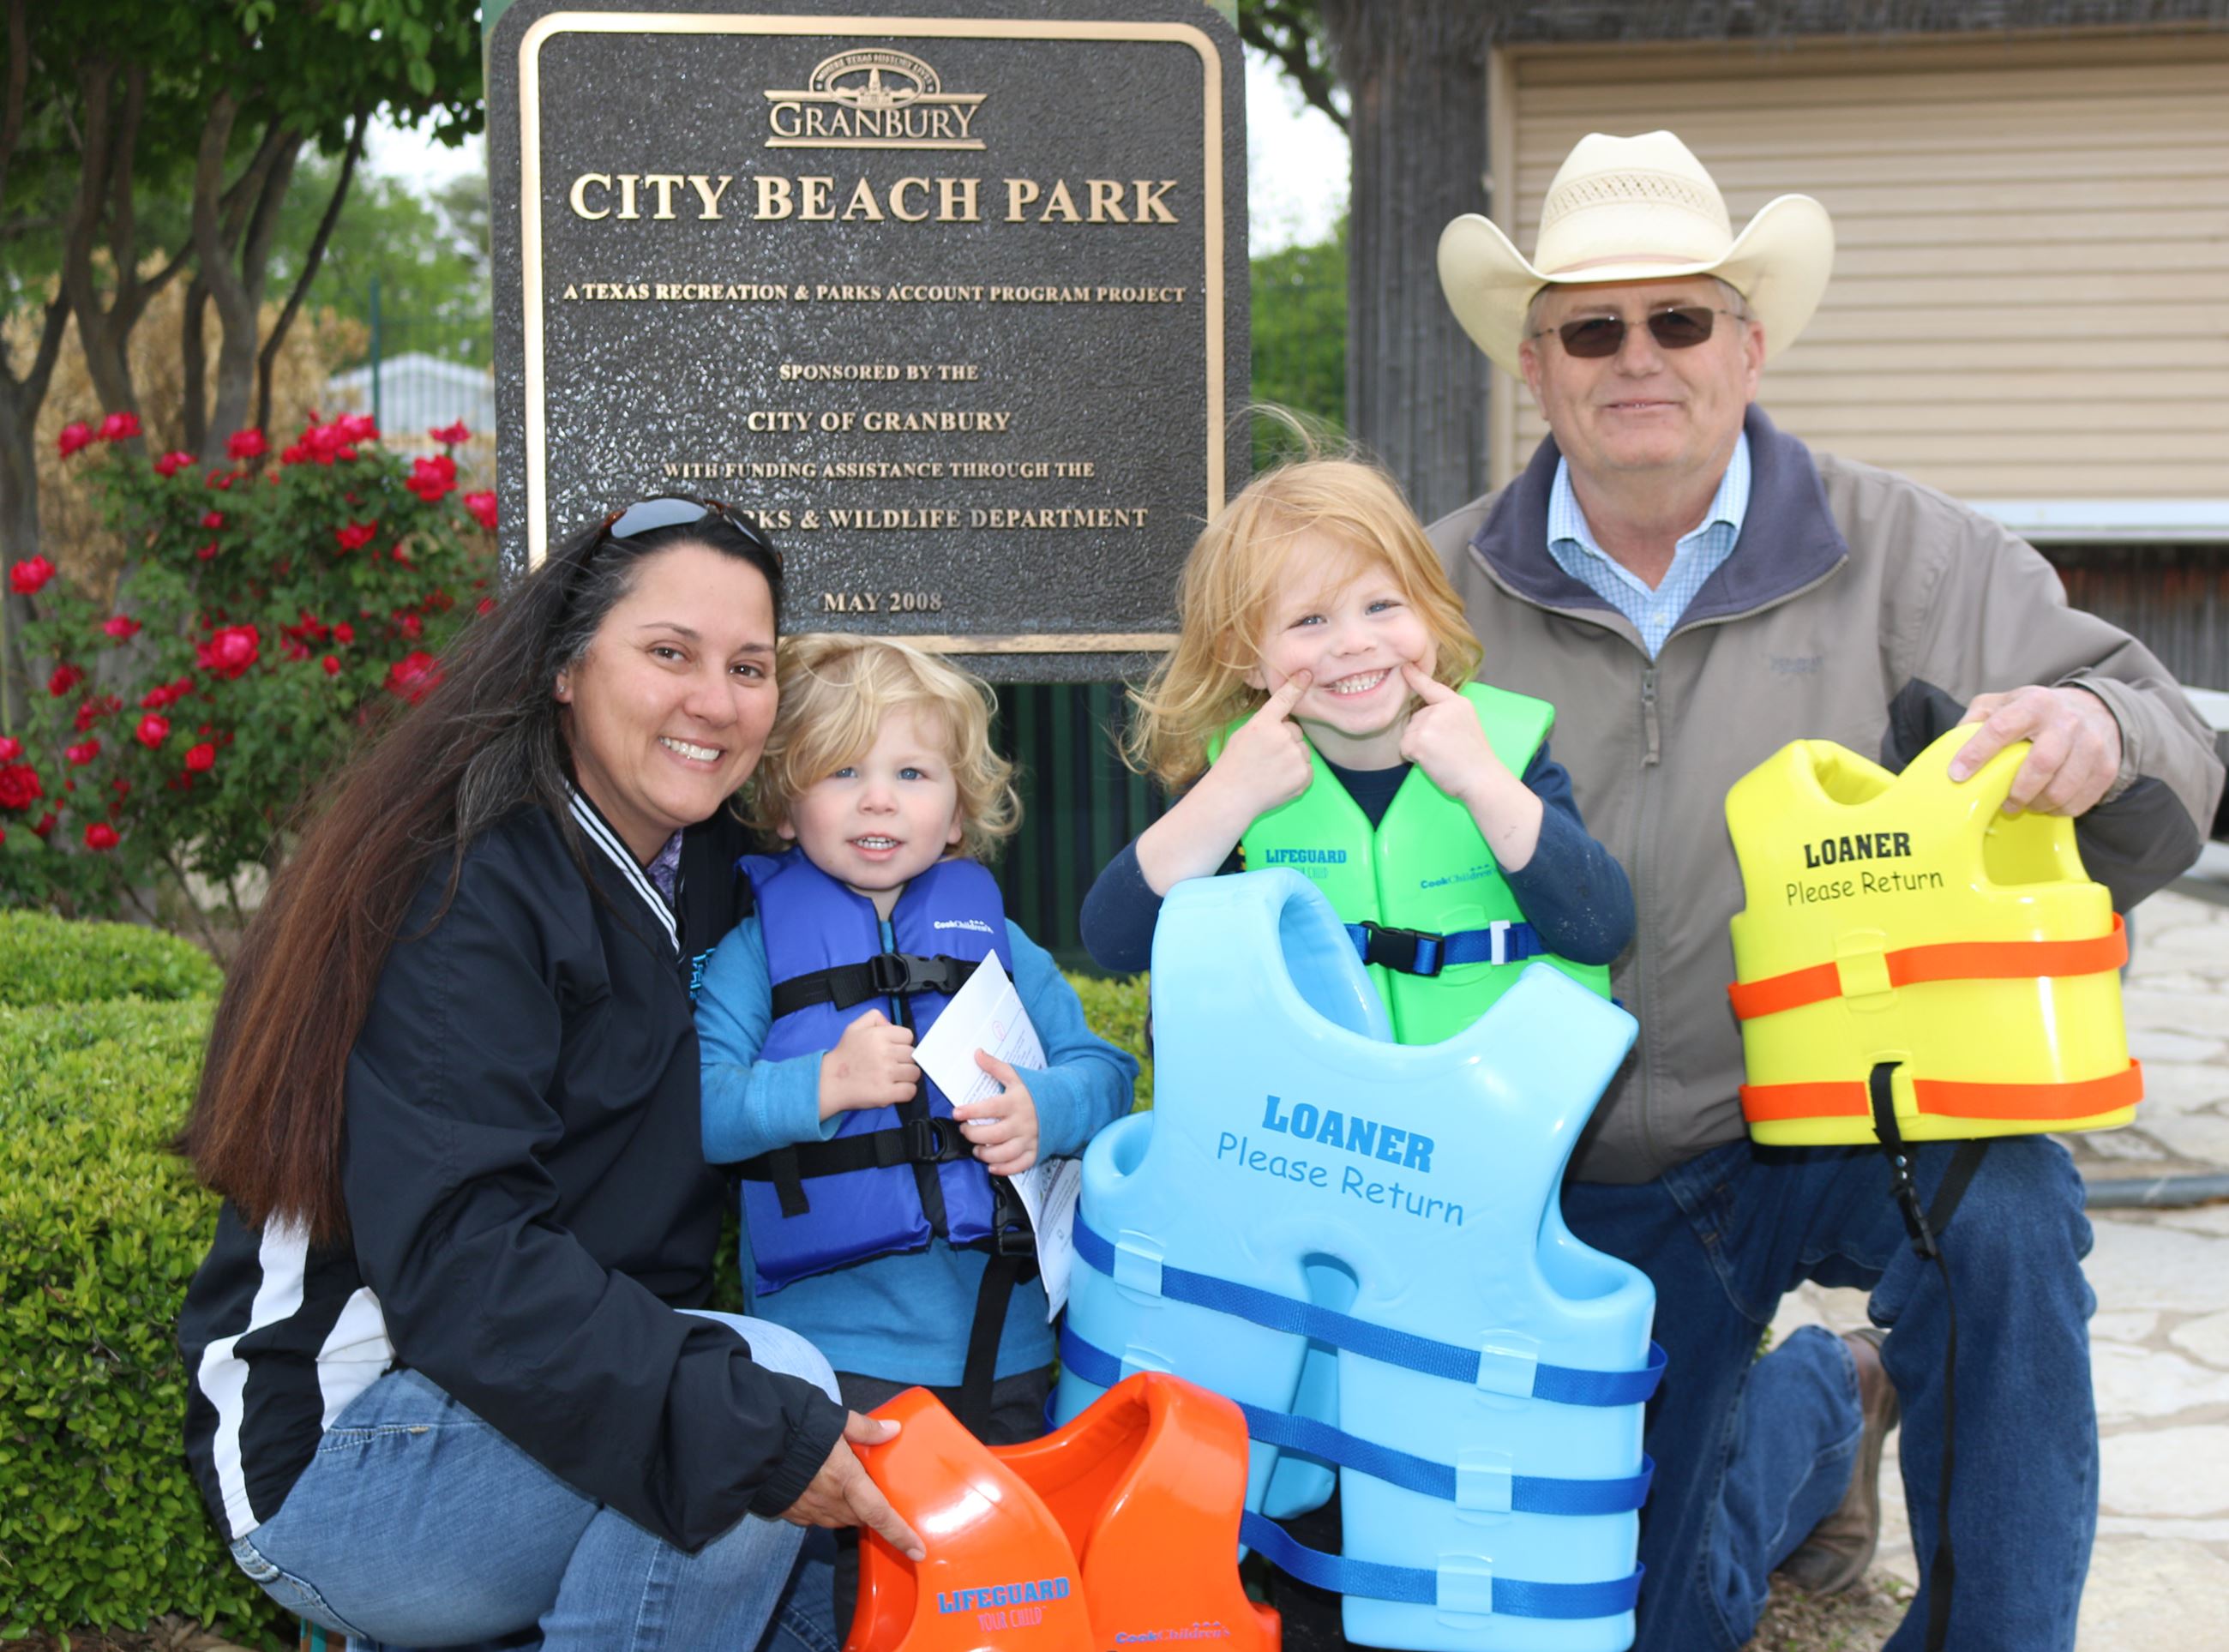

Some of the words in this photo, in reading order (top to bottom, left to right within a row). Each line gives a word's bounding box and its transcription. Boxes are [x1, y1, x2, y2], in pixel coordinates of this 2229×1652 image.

[769, 102, 978, 139] GRANBURY
[569, 172, 733, 220] CITY
[753, 175, 982, 222] BEACH
[1003, 177, 1180, 224] PARK
[563, 284, 579, 300] A
[581, 283, 650, 300] TEXAS
[655, 284, 789, 301] RECREATION
[794, 285, 810, 301] &
[816, 285, 882, 301] PARKS
[886, 285, 984, 302] ACCOUNT
[989, 286, 1090, 302] PROGRAM
[1096, 287, 1187, 302] PROJECT
[779, 364, 901, 381] SPONSORED
[906, 365, 933, 380] BY
[939, 365, 979, 380] THE
[747, 411, 814, 432] CITY
[820, 411, 856, 432] OF
[862, 411, 1012, 432] GRANBURY
[663, 463, 718, 478] WITH
[724, 463, 817, 478] FUNDING
[821, 463, 943, 478] ASSISTANCE
[949, 463, 1049, 478] THROUGH
[1054, 463, 1095, 478] THE
[800, 509, 820, 529] &
[829, 509, 961, 529] WILDLIFE
[970, 508, 1150, 529] DEPARTMENT
[823, 592, 881, 612] MAY
[888, 592, 942, 611] 2008
[1265, 850, 1347, 864] LIFEGUARD
[1804, 832, 1912, 868] LOANER
[1786, 880, 1855, 906] Please
[1860, 870, 1944, 894] Return
[1262, 1095, 1434, 1174] LOANER
[1217, 1132, 1328, 1187] Please
[1341, 1166, 1464, 1227] Return
[937, 1577, 1071, 1613] LIFEGUARD
[976, 1612, 1008, 1632] YOUR
